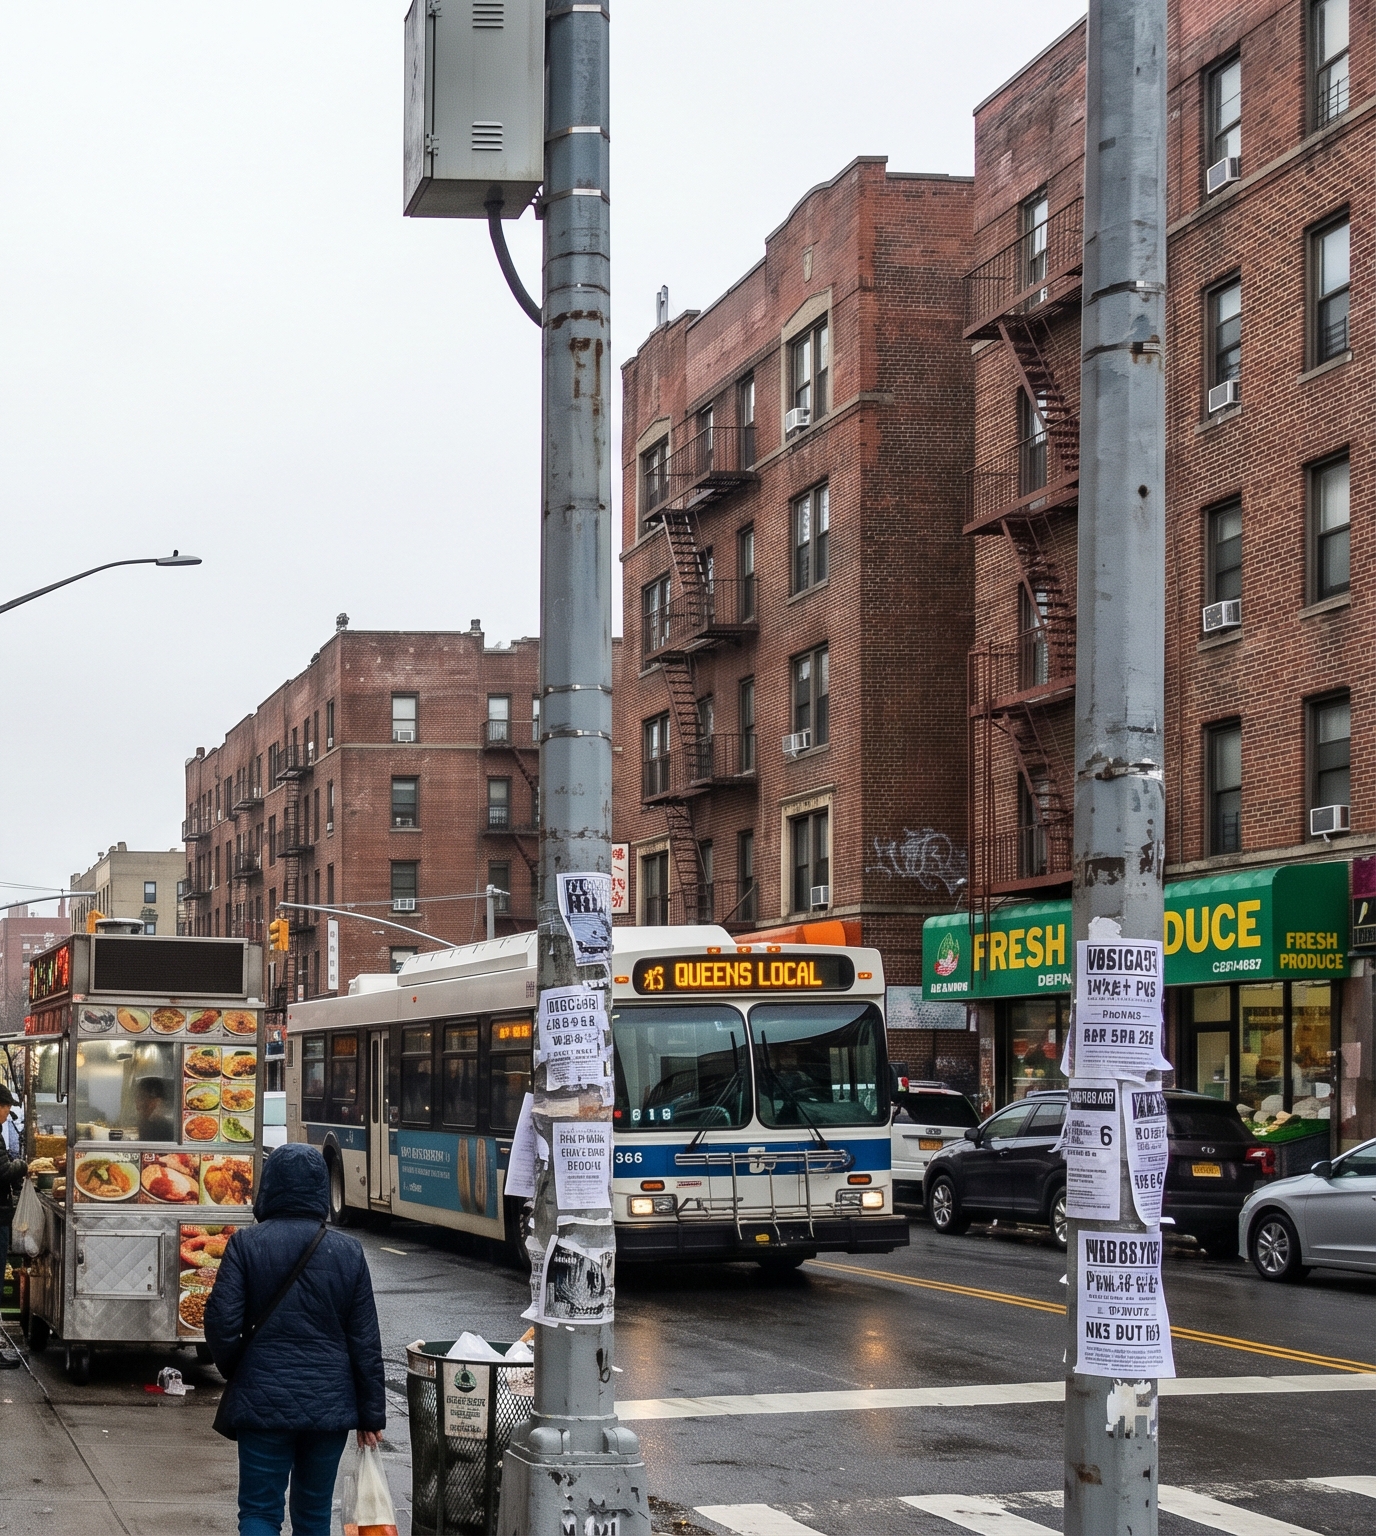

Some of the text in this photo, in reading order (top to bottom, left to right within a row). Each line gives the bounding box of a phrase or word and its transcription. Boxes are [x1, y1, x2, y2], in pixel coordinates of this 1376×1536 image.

[974, 924, 1065, 971] FRESH
[1286, 932, 1337, 949] FRESH
[1280, 953, 1343, 969] PRODUCE
[675, 962, 752, 986] QUEENS
[758, 961, 822, 986] LOCAL
[1100, 1125, 1113, 1146] 6
[615, 1152, 643, 1164] 366
